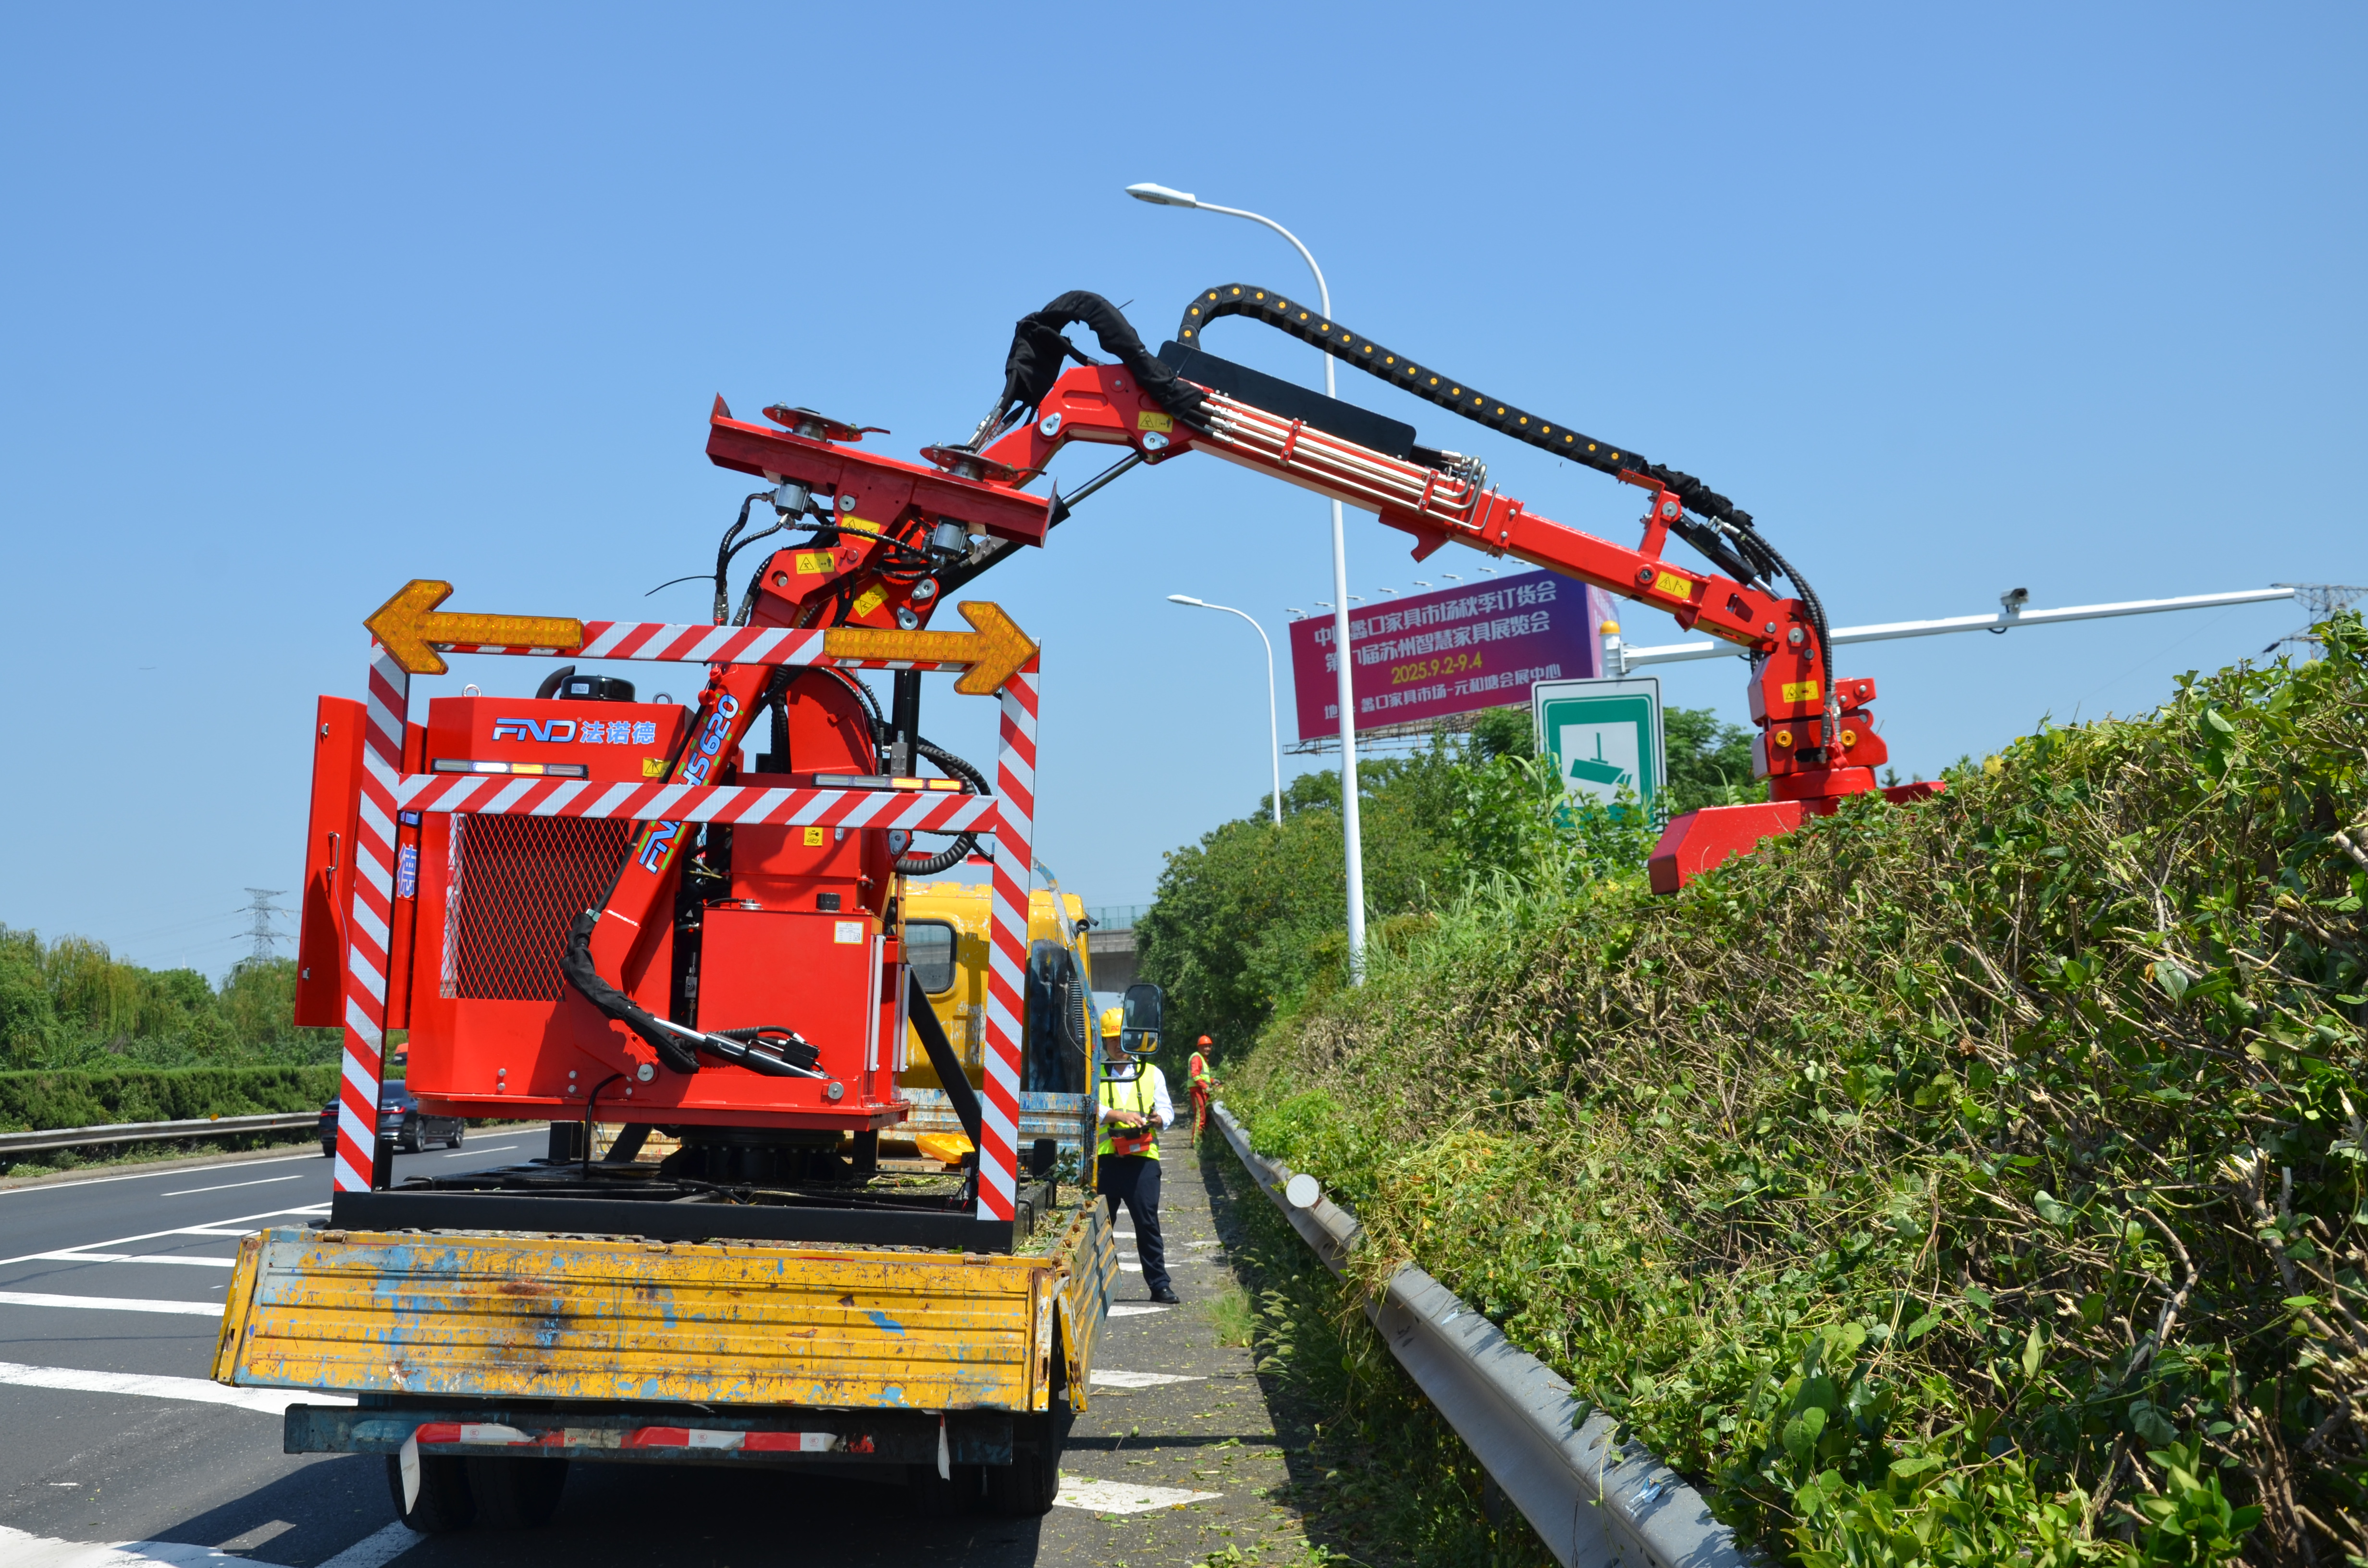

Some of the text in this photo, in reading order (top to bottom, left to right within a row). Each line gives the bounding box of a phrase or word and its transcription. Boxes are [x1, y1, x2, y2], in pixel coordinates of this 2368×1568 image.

[1314, 580, 1557, 647] 中蠡口家具市场秋季订货会
[1325, 611, 1550, 673] 第7届苏州智慧家具展览会
[1392, 651, 1482, 685] 2025.9.2-9.4
[492, 718, 656, 745] FND 法诺德
